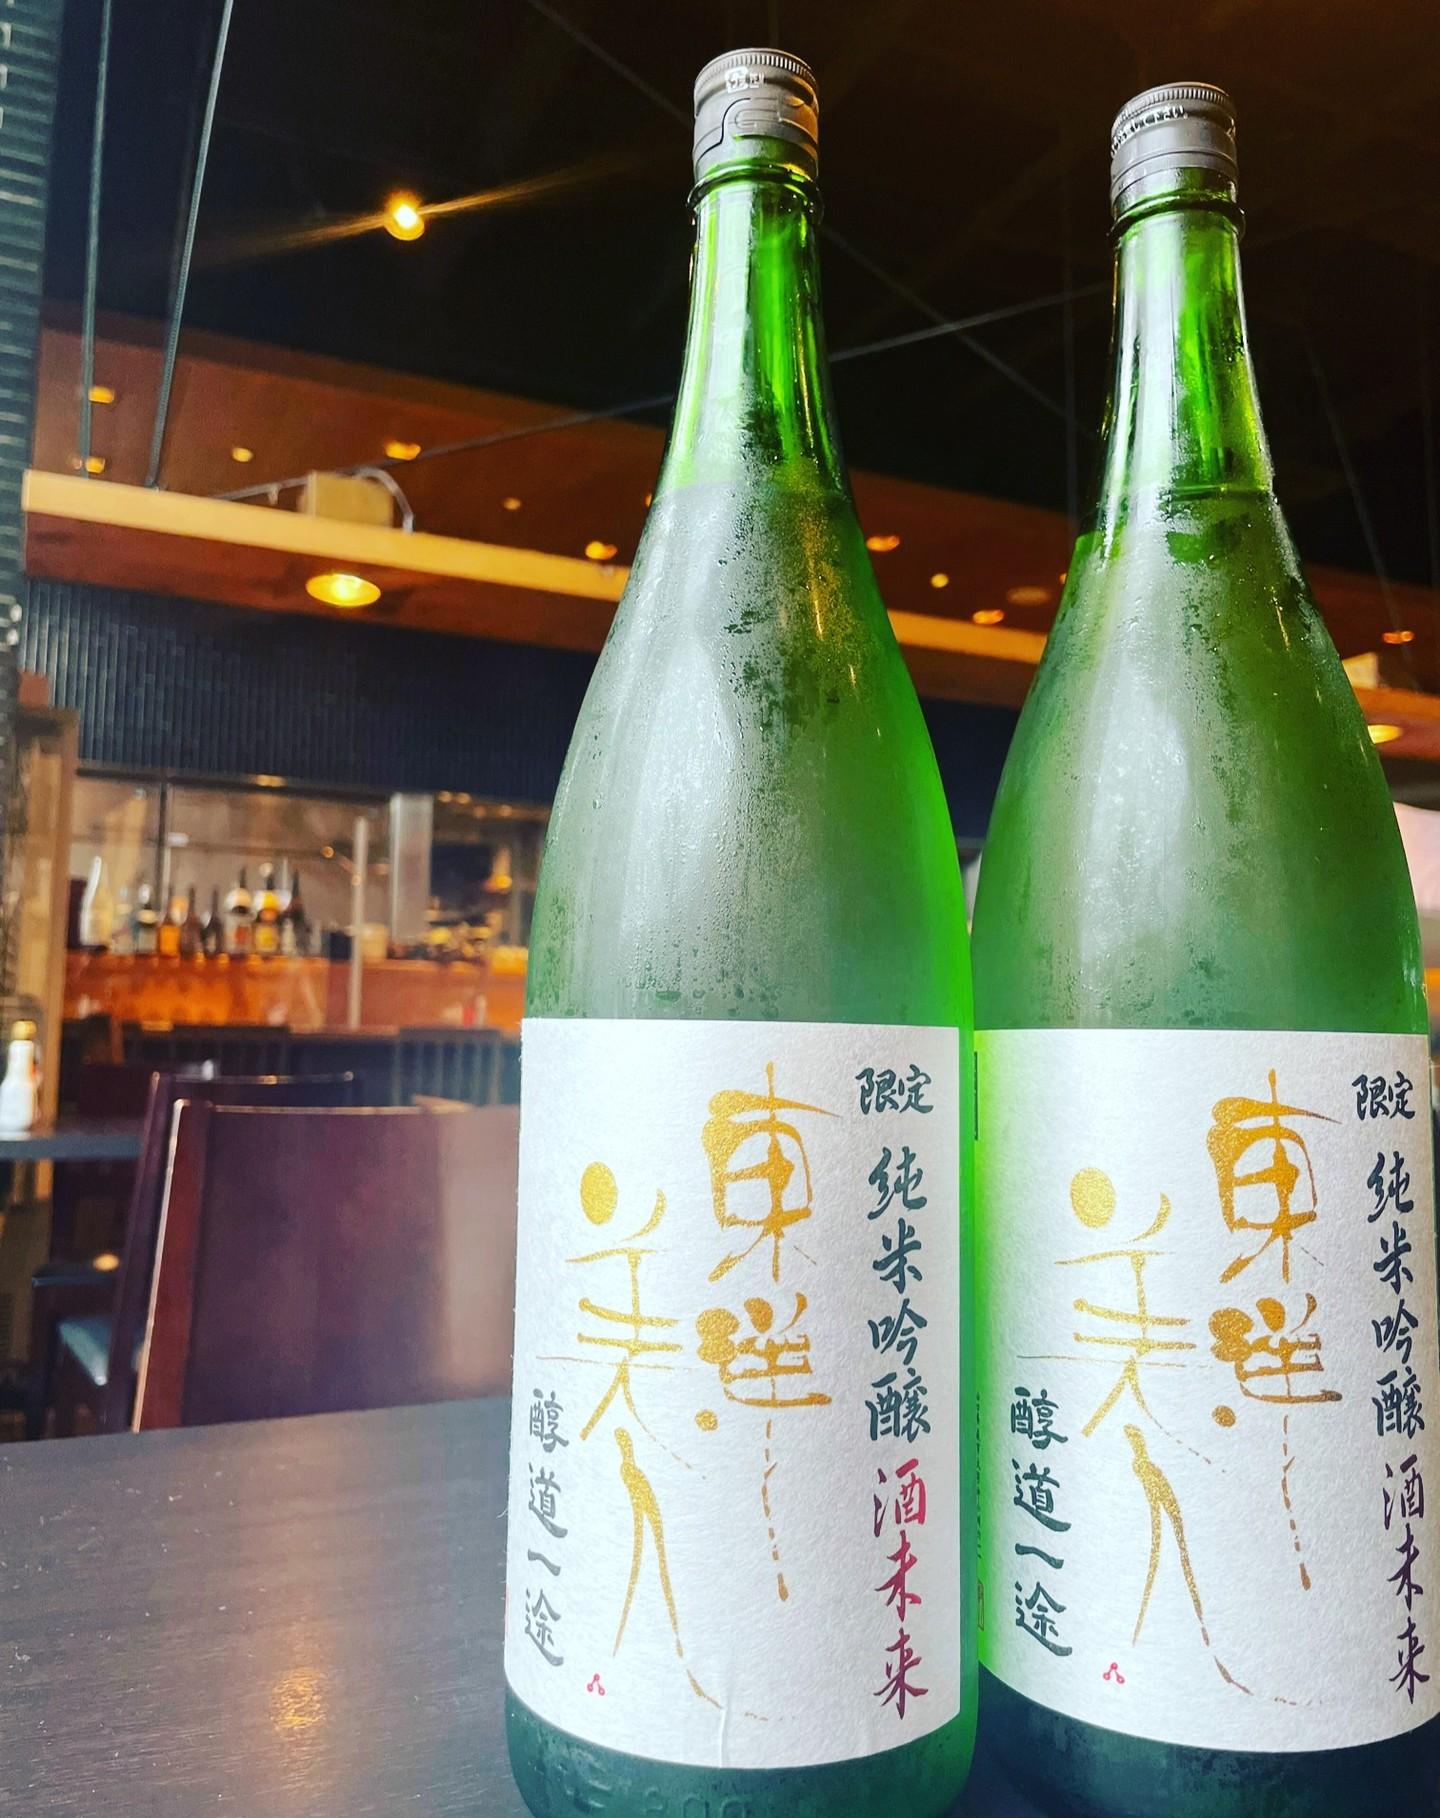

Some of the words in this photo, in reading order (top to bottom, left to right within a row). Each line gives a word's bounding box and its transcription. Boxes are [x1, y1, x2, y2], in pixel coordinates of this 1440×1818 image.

[855, 1064, 933, 1116] 限定
[1352, 1070, 1416, 1122] 限定
[527, 1388, 571, 1668] 醇道一途
[1010, 1386, 1073, 1659] 醇道一途
